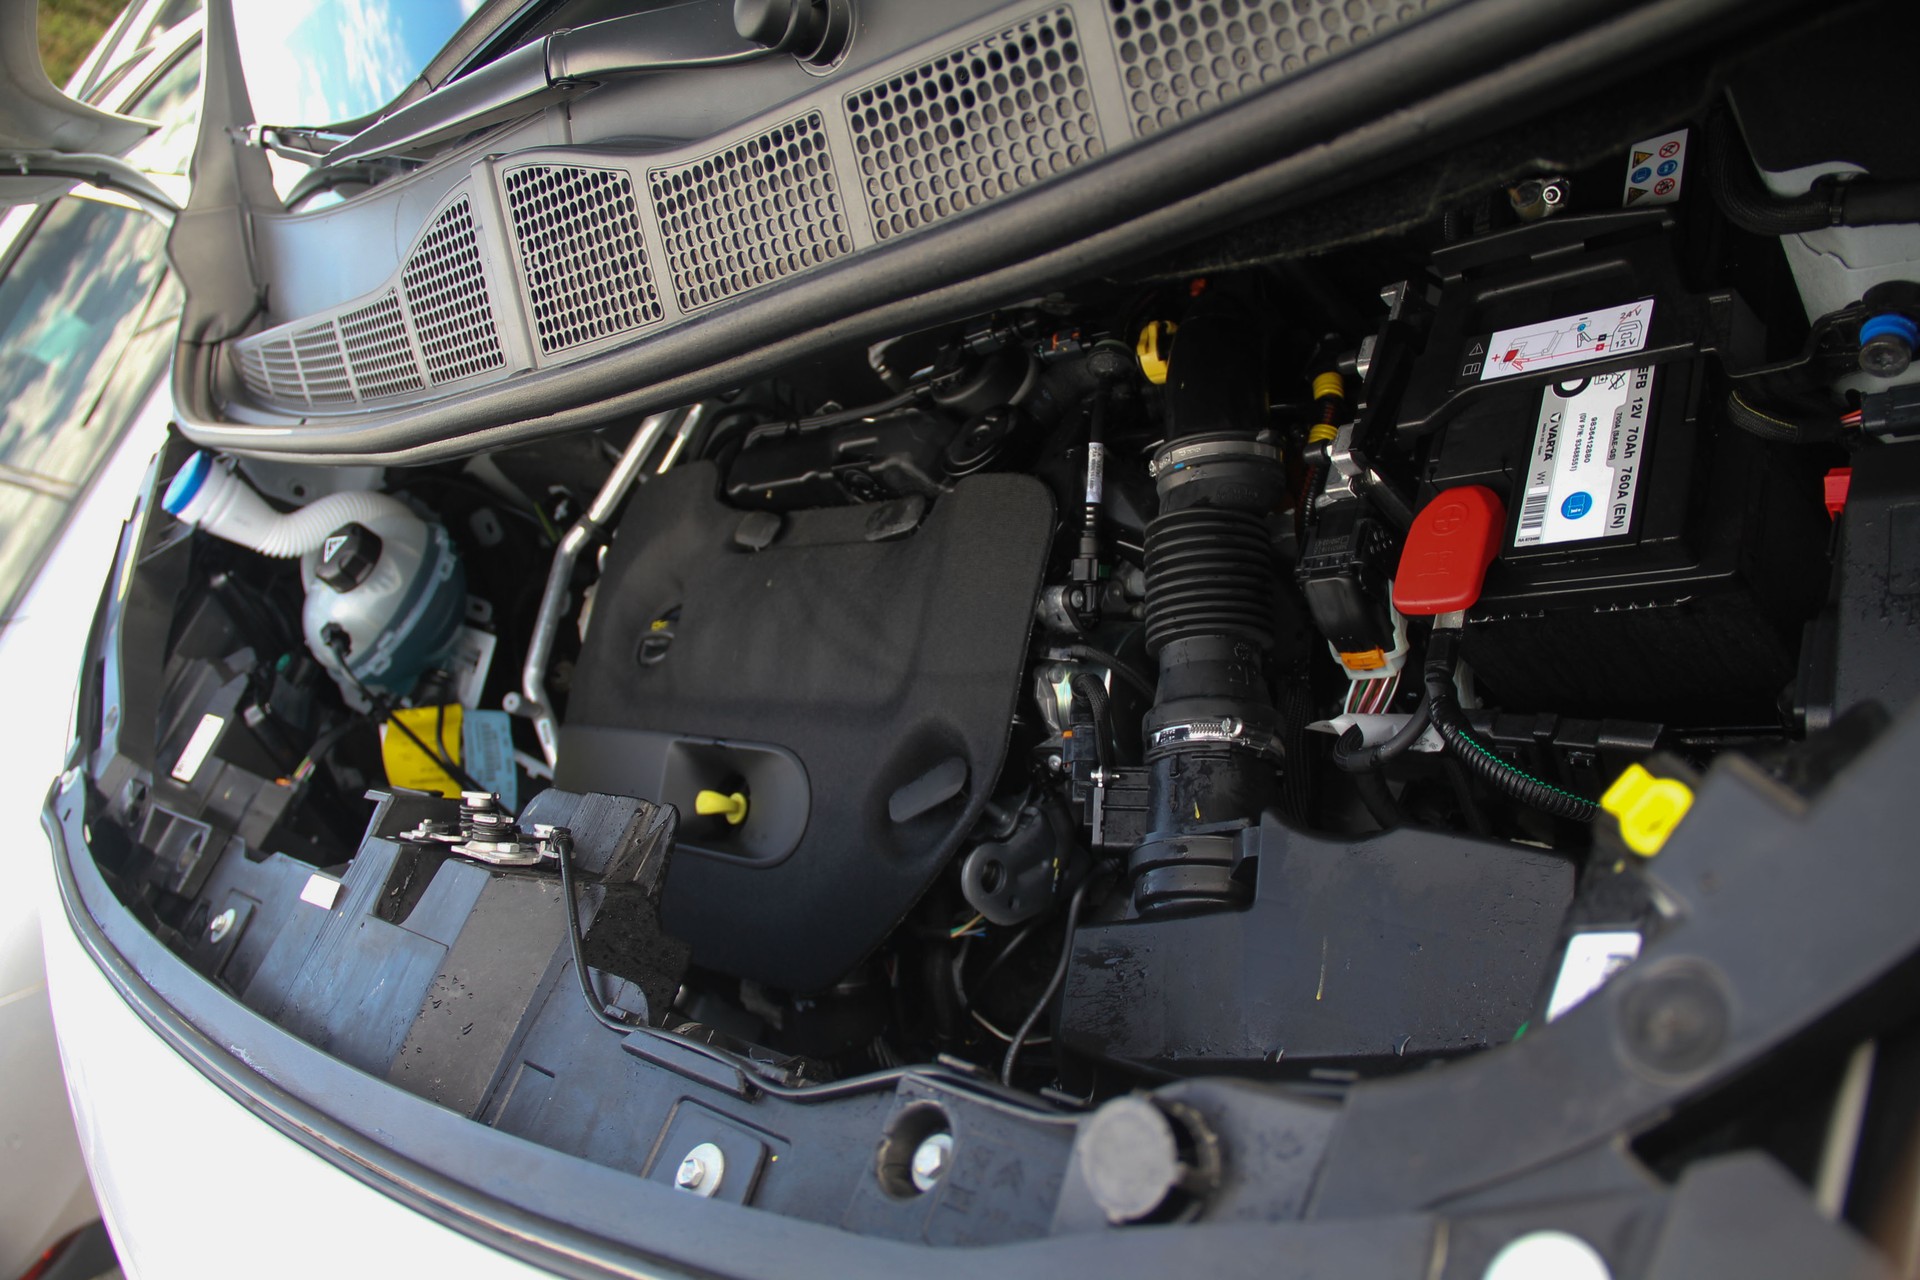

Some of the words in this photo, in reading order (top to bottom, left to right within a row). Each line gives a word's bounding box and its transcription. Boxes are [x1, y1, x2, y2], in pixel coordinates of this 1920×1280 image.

[1615, 340, 1626, 348] 12
[1636, 366, 1648, 389] EFB
[1631, 397, 1643, 419] 12V
[1615, 412, 1623, 429] 700A
[1544, 424, 1558, 461] VARTA
[1584, 417, 1598, 463] 9836412880
[1624, 426, 1639, 459] 70Ah
[1535, 471, 1546, 485] W1
[1617, 466, 1632, 500] 760A
[1610, 503, 1627, 529] (EN)
